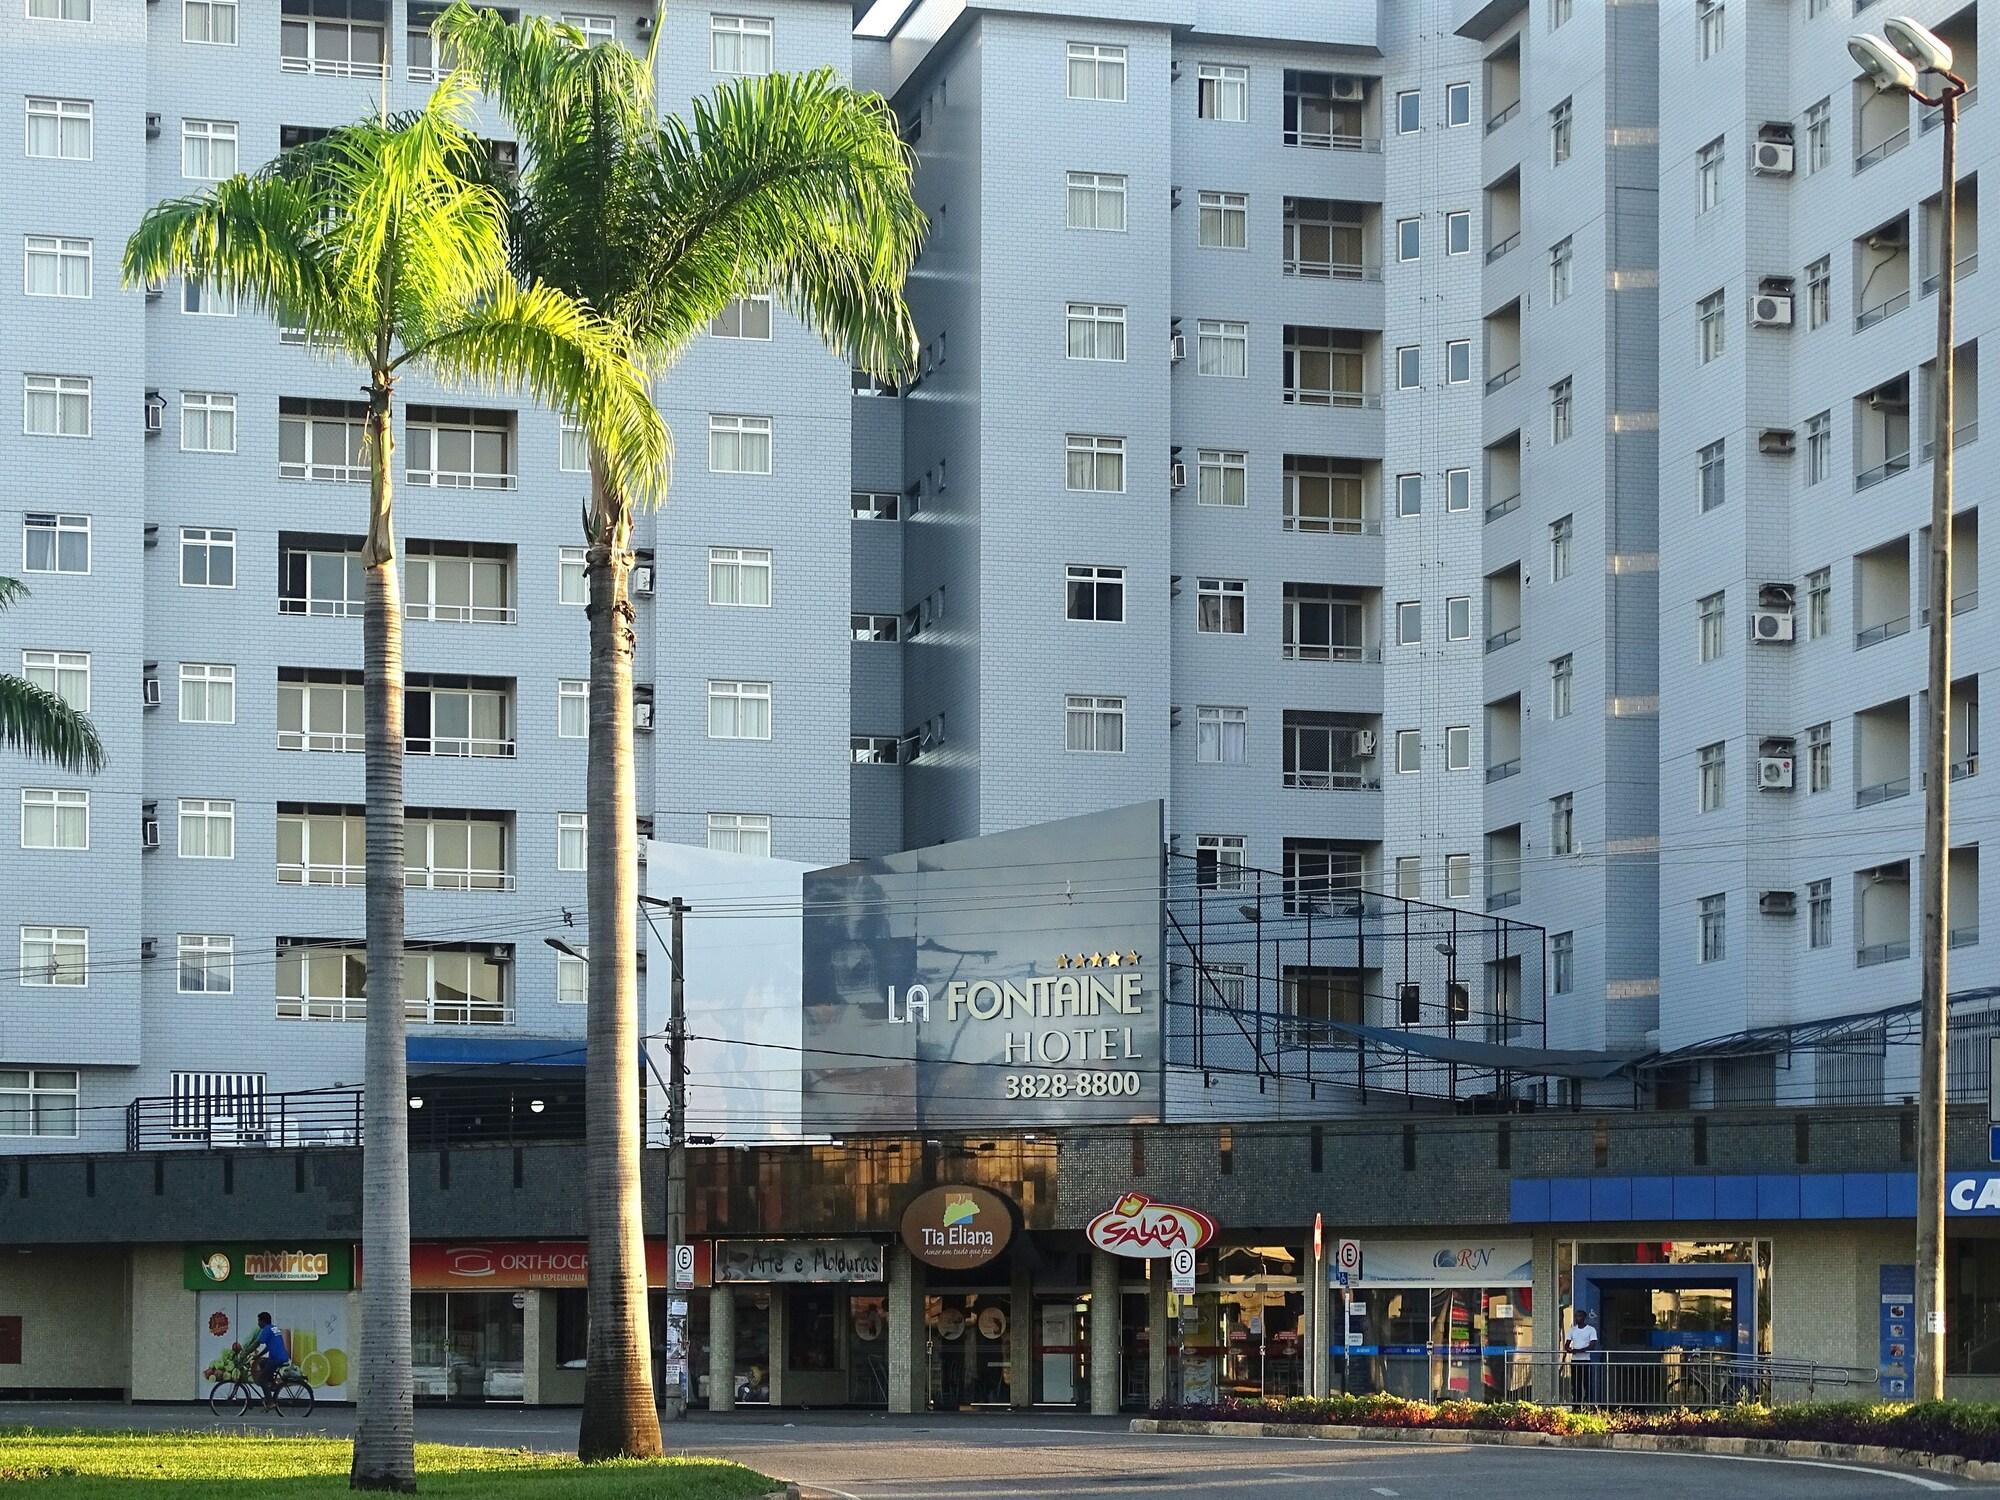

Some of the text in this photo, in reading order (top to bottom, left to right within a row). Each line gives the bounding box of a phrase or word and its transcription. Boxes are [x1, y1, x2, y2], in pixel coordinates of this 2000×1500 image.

[888, 973, 1142, 1023] LA FONTAINE
[1005, 1027, 1142, 1063] HOTEL
[1005, 1071, 1141, 1099] 3828-8800
[921, 1225, 993, 1246] Tia Eliana
[1102, 1214, 1188, 1250] SALADA
[245, 1250, 328, 1273] mixirica
[682, 1252, 687, 1264] E
[751, 1248, 879, 1274] Arte e Molduras
[1180, 1256, 1187, 1268] E
[1347, 1249, 1352, 1262] E
[1457, 1248, 1495, 1270] RN
